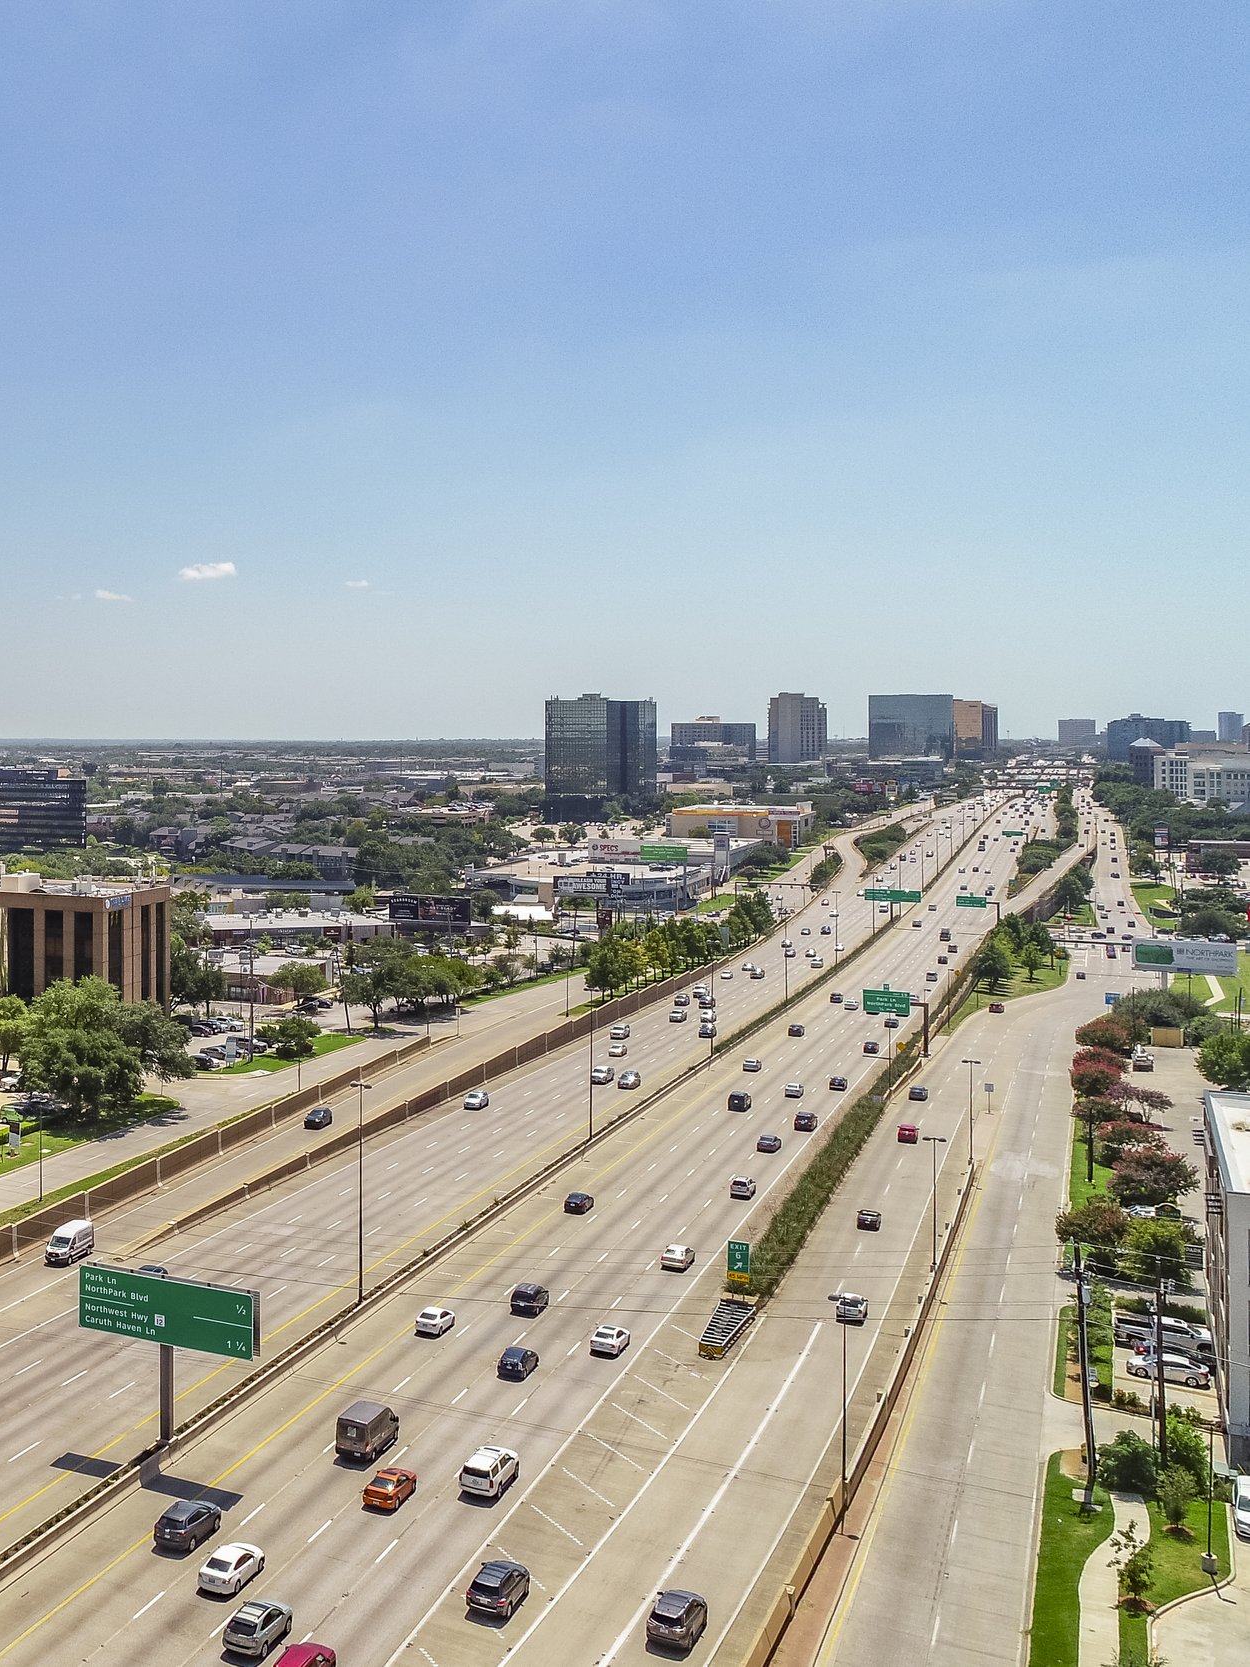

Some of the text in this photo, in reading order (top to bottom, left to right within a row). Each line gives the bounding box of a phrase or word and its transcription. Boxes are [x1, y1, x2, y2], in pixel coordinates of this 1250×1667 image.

[1185, 948, 1234, 958] NORTHPARK
[85, 1272, 117, 1285] Park Ln
[85, 1284, 149, 1303] NorthPark Blvd
[85, 1303, 128, 1318] Northwest
[131, 1311, 149, 1323] Hwy
[85, 1315, 156, 1336] Caruth Haven Ln
